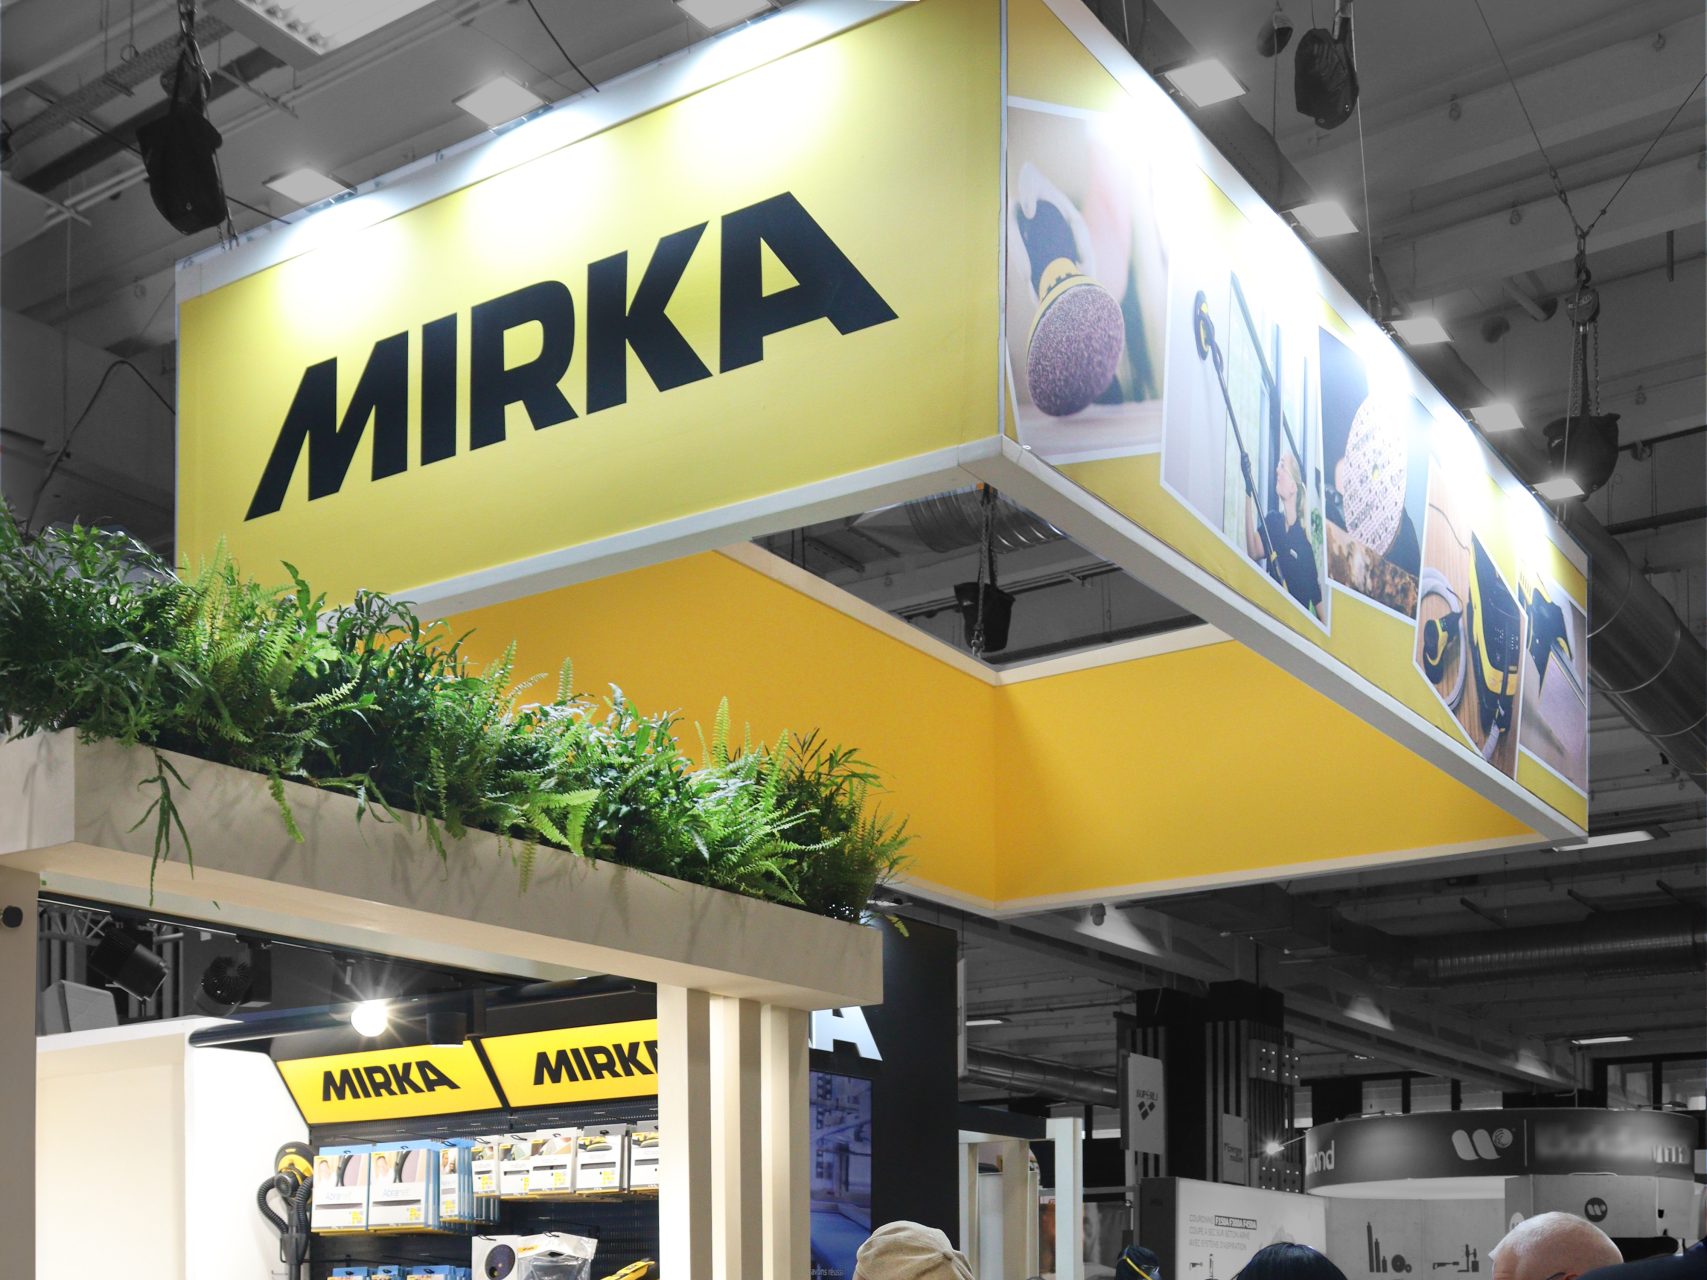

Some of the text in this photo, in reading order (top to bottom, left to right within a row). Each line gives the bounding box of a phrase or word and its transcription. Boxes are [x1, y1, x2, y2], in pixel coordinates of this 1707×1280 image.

[243, 191, 899, 522] MIRKA
[322, 1060, 461, 1102] MIRKA
[533, 1040, 658, 1085] MIRK
